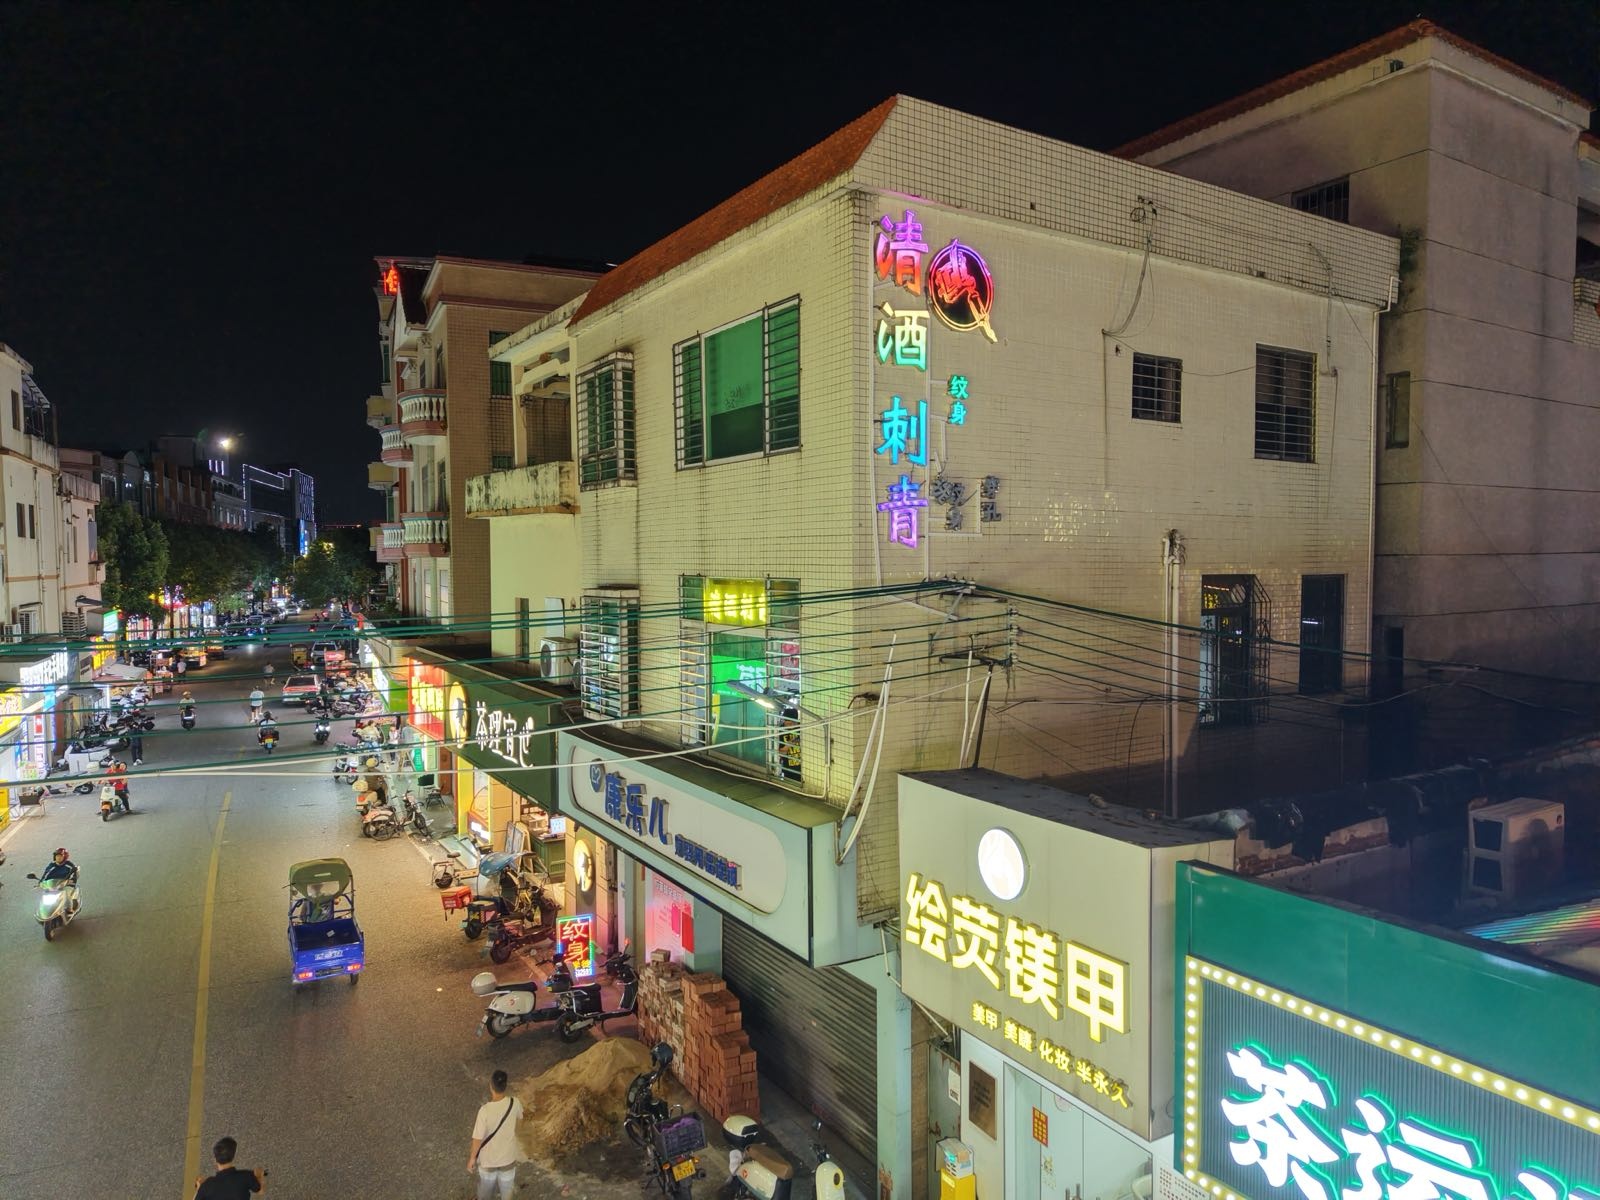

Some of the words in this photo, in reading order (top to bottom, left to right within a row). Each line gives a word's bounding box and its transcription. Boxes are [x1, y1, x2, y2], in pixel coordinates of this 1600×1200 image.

[875, 210, 928, 548] 清酒刺青
[947, 375, 969, 426] 纹身
[475, 700, 535, 769] 茶理宜世
[605, 772, 670, 845] 康乐儿
[562, 919, 589, 963] 纹身
[905, 872, 1130, 1043] 绘荧镁甲
[972, 1001, 998, 1030] 美甲
[1039, 1038, 1072, 1074] 化妆
[1076, 1057, 1129, 1108] 半永久
